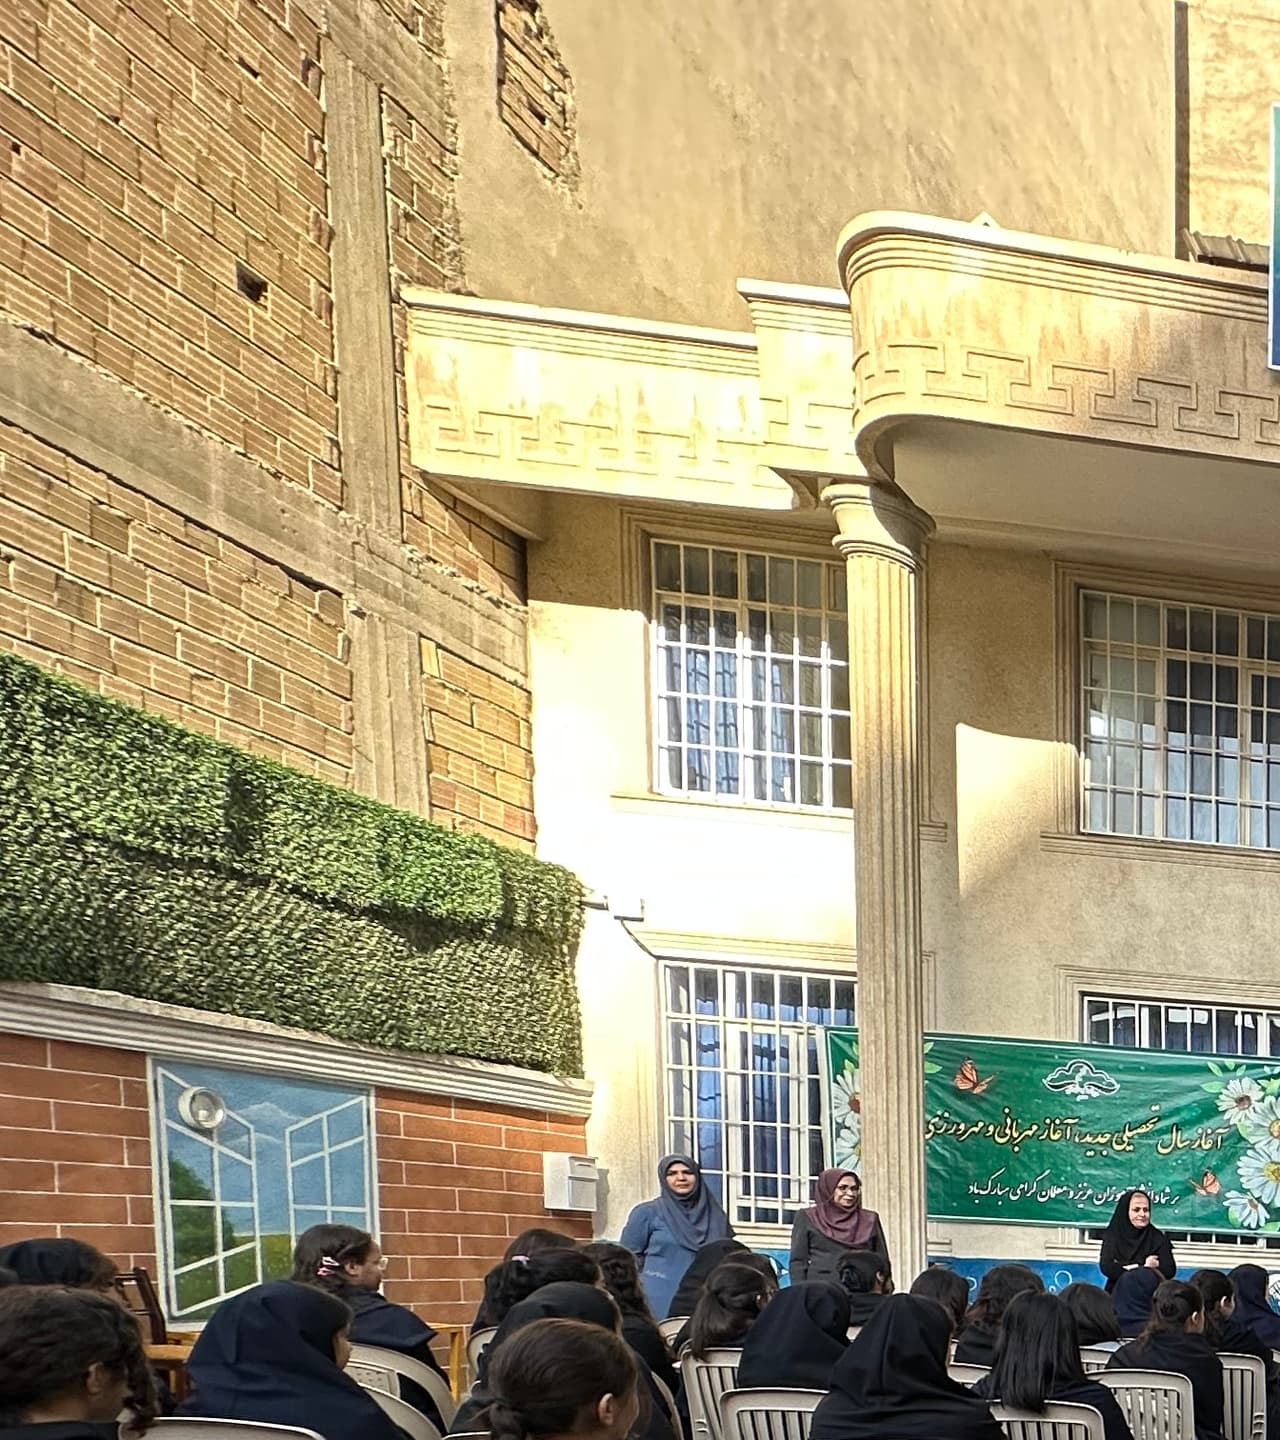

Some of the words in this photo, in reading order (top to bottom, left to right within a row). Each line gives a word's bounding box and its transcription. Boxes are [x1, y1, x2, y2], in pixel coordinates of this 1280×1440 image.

[994, 1106, 1039, 1153] مهربانی
[1038, 1117, 1080, 1141] آغاز
[1111, 1103, 1160, 1152] تحصیلی
[1156, 1123, 1191, 1155] سال
[1190, 1126, 1230, 1151] آغاز
[1036, 1185, 1067, 1203] معلمان
[1073, 1181, 1094, 1209] عزیز
[1170, 1194, 1181, 1215] بر
